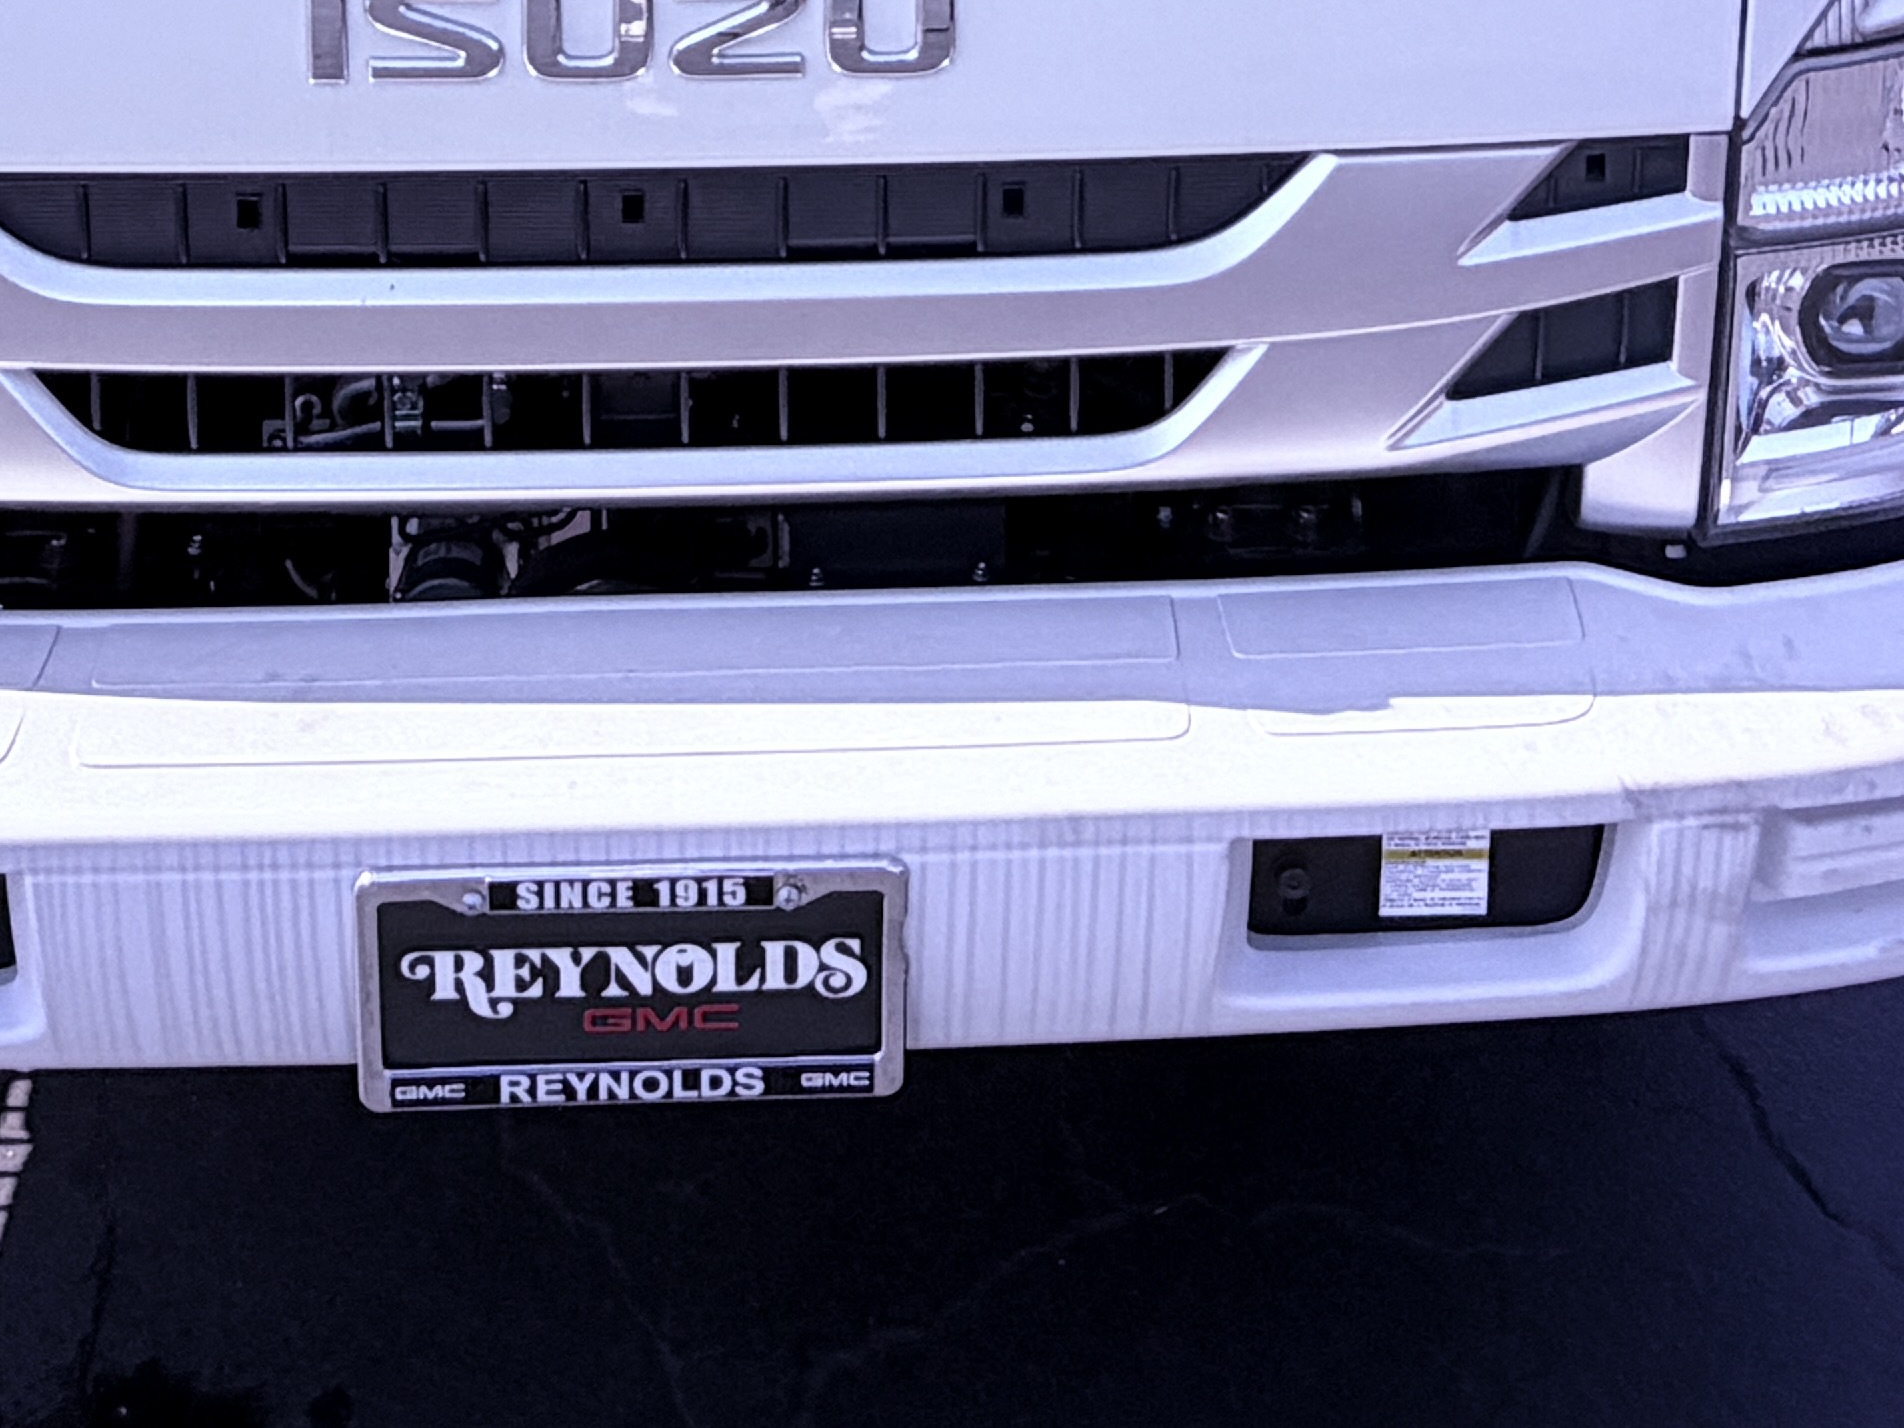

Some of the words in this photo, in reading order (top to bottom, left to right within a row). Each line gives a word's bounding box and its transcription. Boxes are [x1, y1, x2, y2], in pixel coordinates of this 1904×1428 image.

[516, 880, 634, 910] SINCE
[653, 878, 748, 908] 1915
[400, 937, 869, 1019] REYNOLDS
[582, 1004, 740, 1033] GMC
[395, 1082, 466, 1101] GMC
[499, 1066, 766, 1105] REYNOLDS
[800, 1070, 871, 1090] GMC
